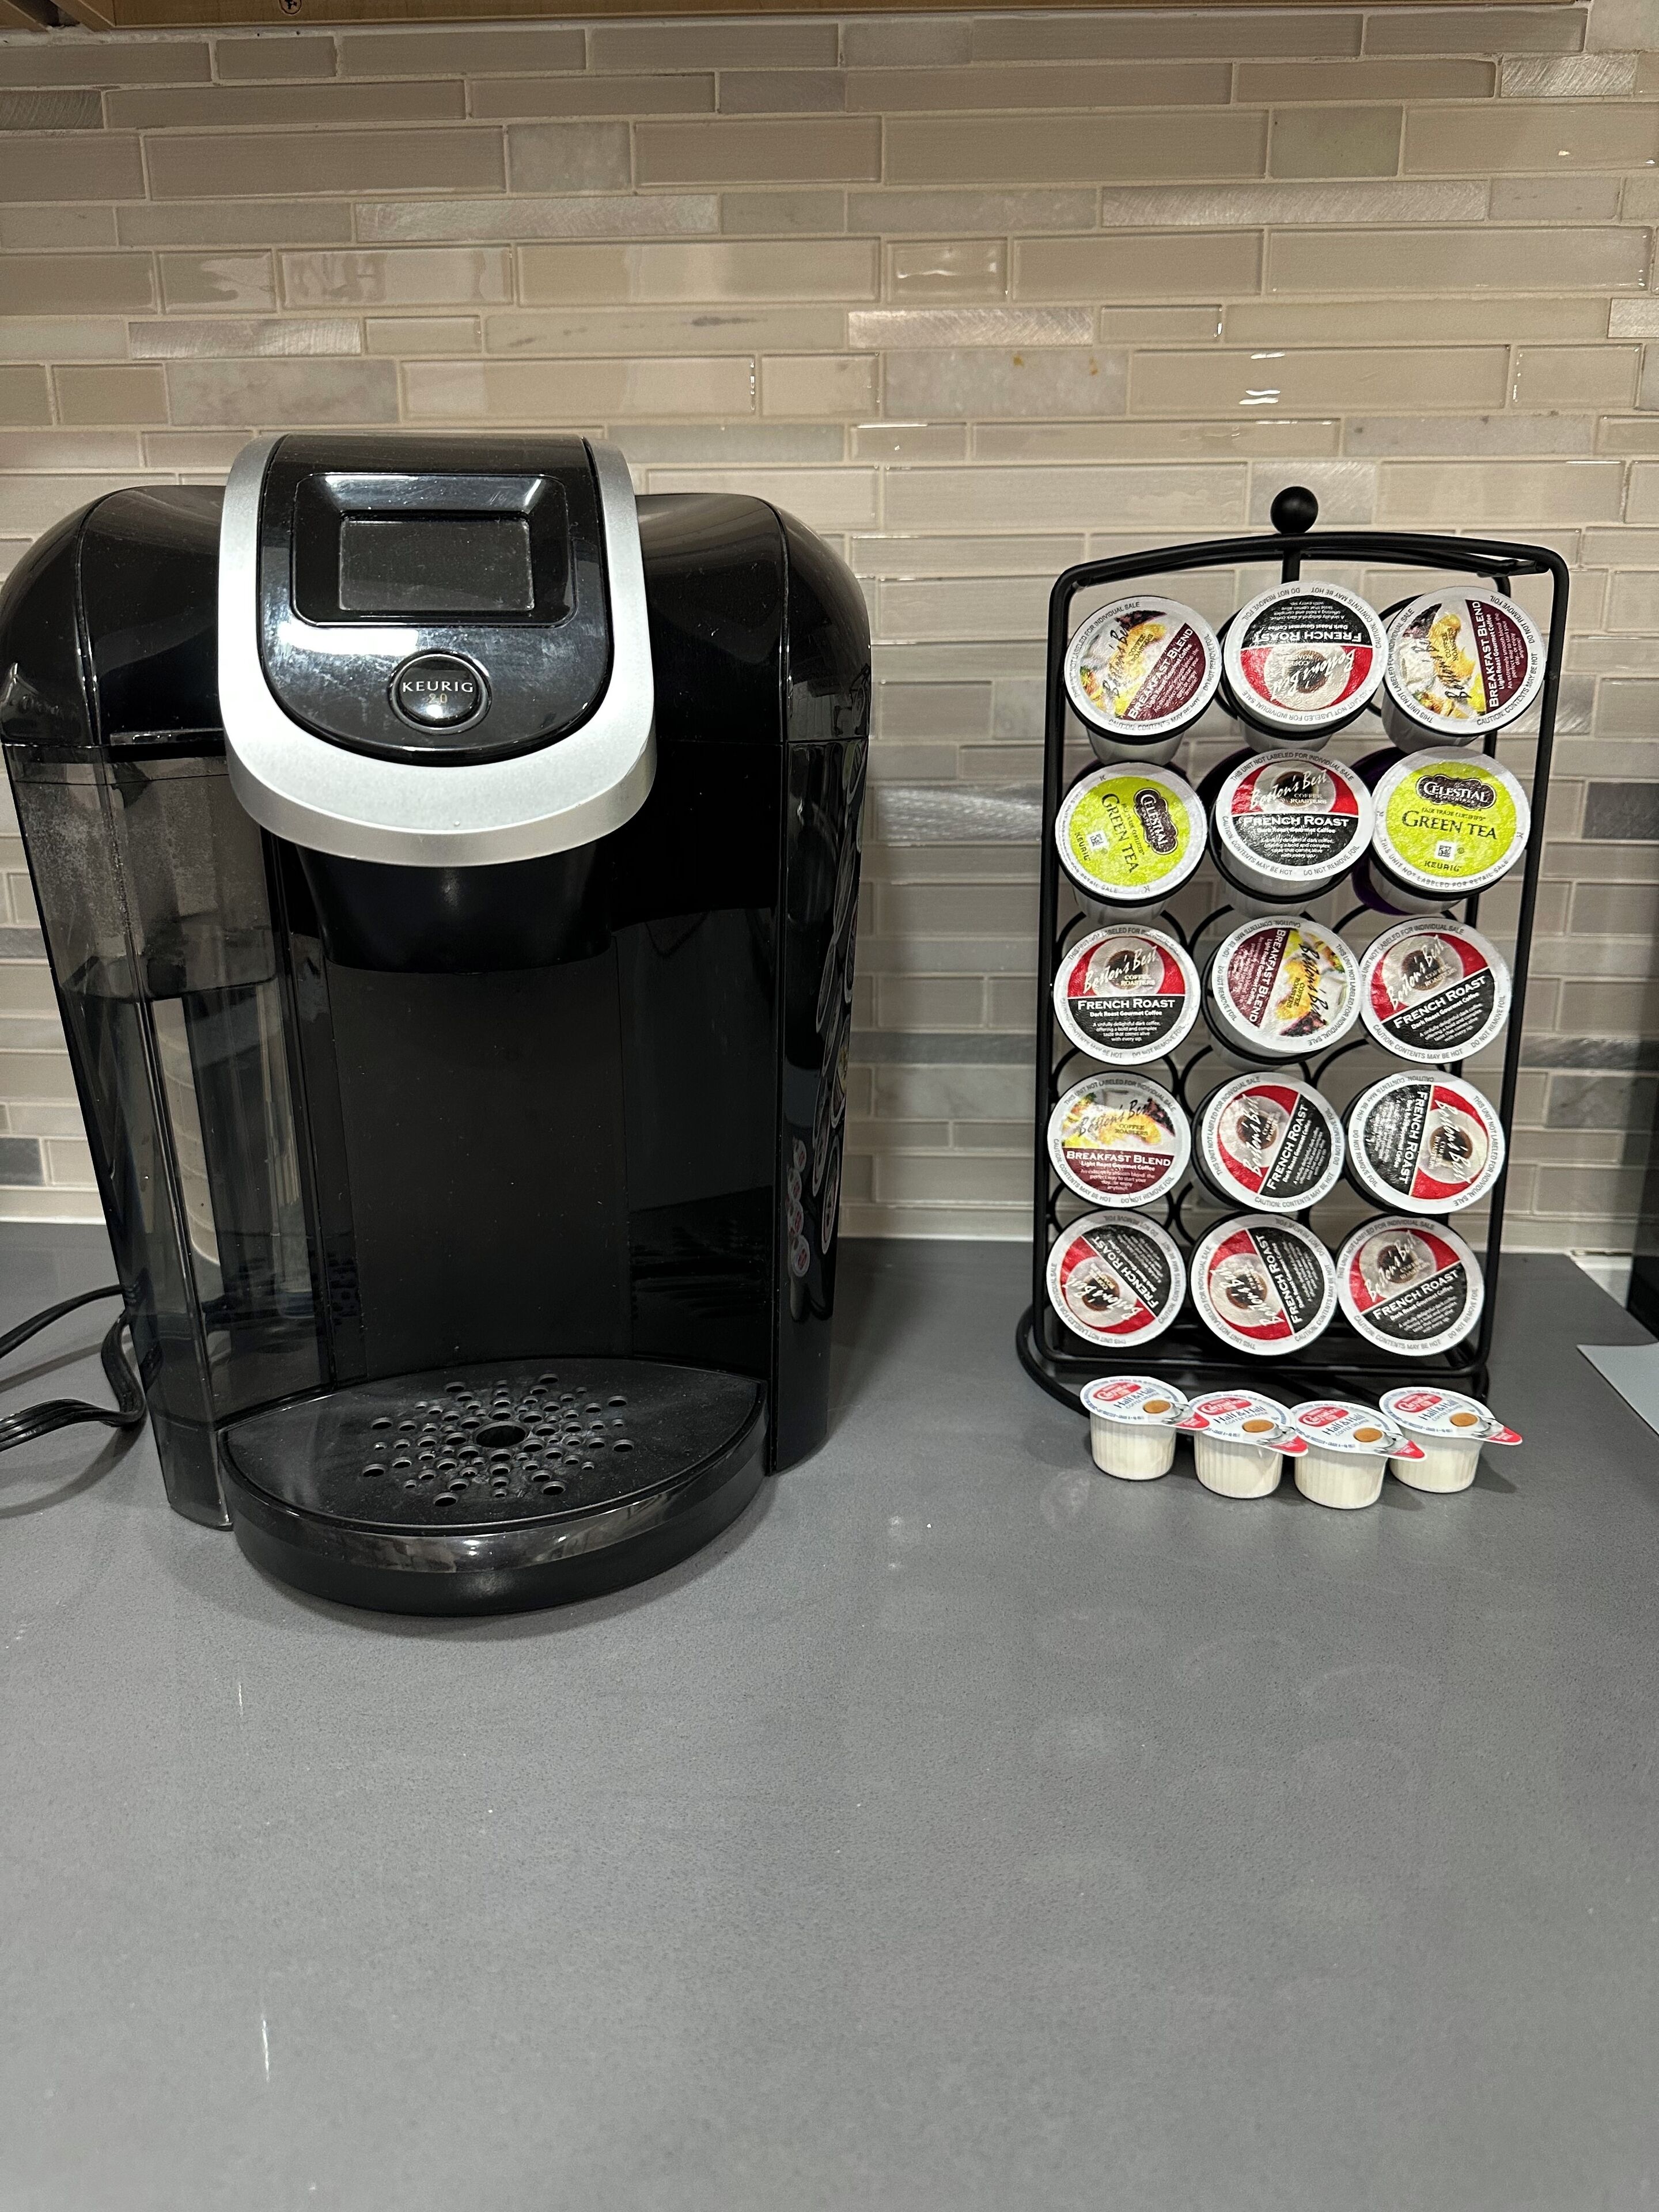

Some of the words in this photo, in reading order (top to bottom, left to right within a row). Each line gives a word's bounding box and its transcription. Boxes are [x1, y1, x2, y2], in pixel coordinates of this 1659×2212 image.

[1472, 601, 1488, 637] BLEND
[1253, 631, 1300, 642] ROAST
[1303, 632, 1362, 642] FRENCH
[403, 681, 473, 692] KEURIG
[1128, 658, 1171, 719] BREAKFAST
[1167, 628, 1193, 659] BLEND
[1481, 639, 1499, 707] BREAKFAST
[1267, 752, 1293, 760] LABELED
[1423, 782, 1489, 802] CELESTIAL
[1101, 794, 1130, 842] GREEN
[1122, 843, 1139, 873] TEA
[1141, 794, 1168, 847] CELESTIAL
[1244, 817, 1300, 825] FRENCH
[1304, 816, 1349, 827] ROAST
[1402, 810, 1462, 833] GREEN
[1467, 823, 1497, 840] TEA
[1424, 861, 1461, 872] KEURIG
[1262, 930, 1286, 984] BREAKFAST
[1078, 1000, 1131, 1010] FRENCH
[1133, 999, 1175, 1008] ROAST
[1249, 983, 1269, 1022] BLEND
[1393, 997, 1446, 1029] FRENCH
[1445, 976, 1486, 1002] ROAST
[1411, 1020, 1425, 1030] Dark
[1424, 1013, 1441, 1024] Roast
[1409, 1091, 1429, 1141] FRENCH
[1067, 1151, 1131, 1162] BREAKFAST
[1133, 1155, 1171, 1166] BLEND
[1266, 1143, 1294, 1190] FRENCH
[1289, 1105, 1309, 1142] ROAST
[1400, 1142, 1418, 1184] ROAST
[1092, 1236, 1123, 1269] ROAST
[1256, 1235, 1279, 1274] ROAST
[1122, 1270, 1159, 1308] FRENCH
[1275, 1275, 1303, 1323] FRENCH
[1373, 1290, 1422, 1320] FRENCH
[1421, 1270, 1459, 1295] ROAST
[1113, 1397, 1132, 1408] Half
[1213, 1412, 1236, 1424] Half
[1244, 1406, 1266, 1414] Half
[1419, 1408, 1437, 1420] Half
[1444, 1399, 1459, 1408] Half
[1321, 1422, 1342, 1435] Half
